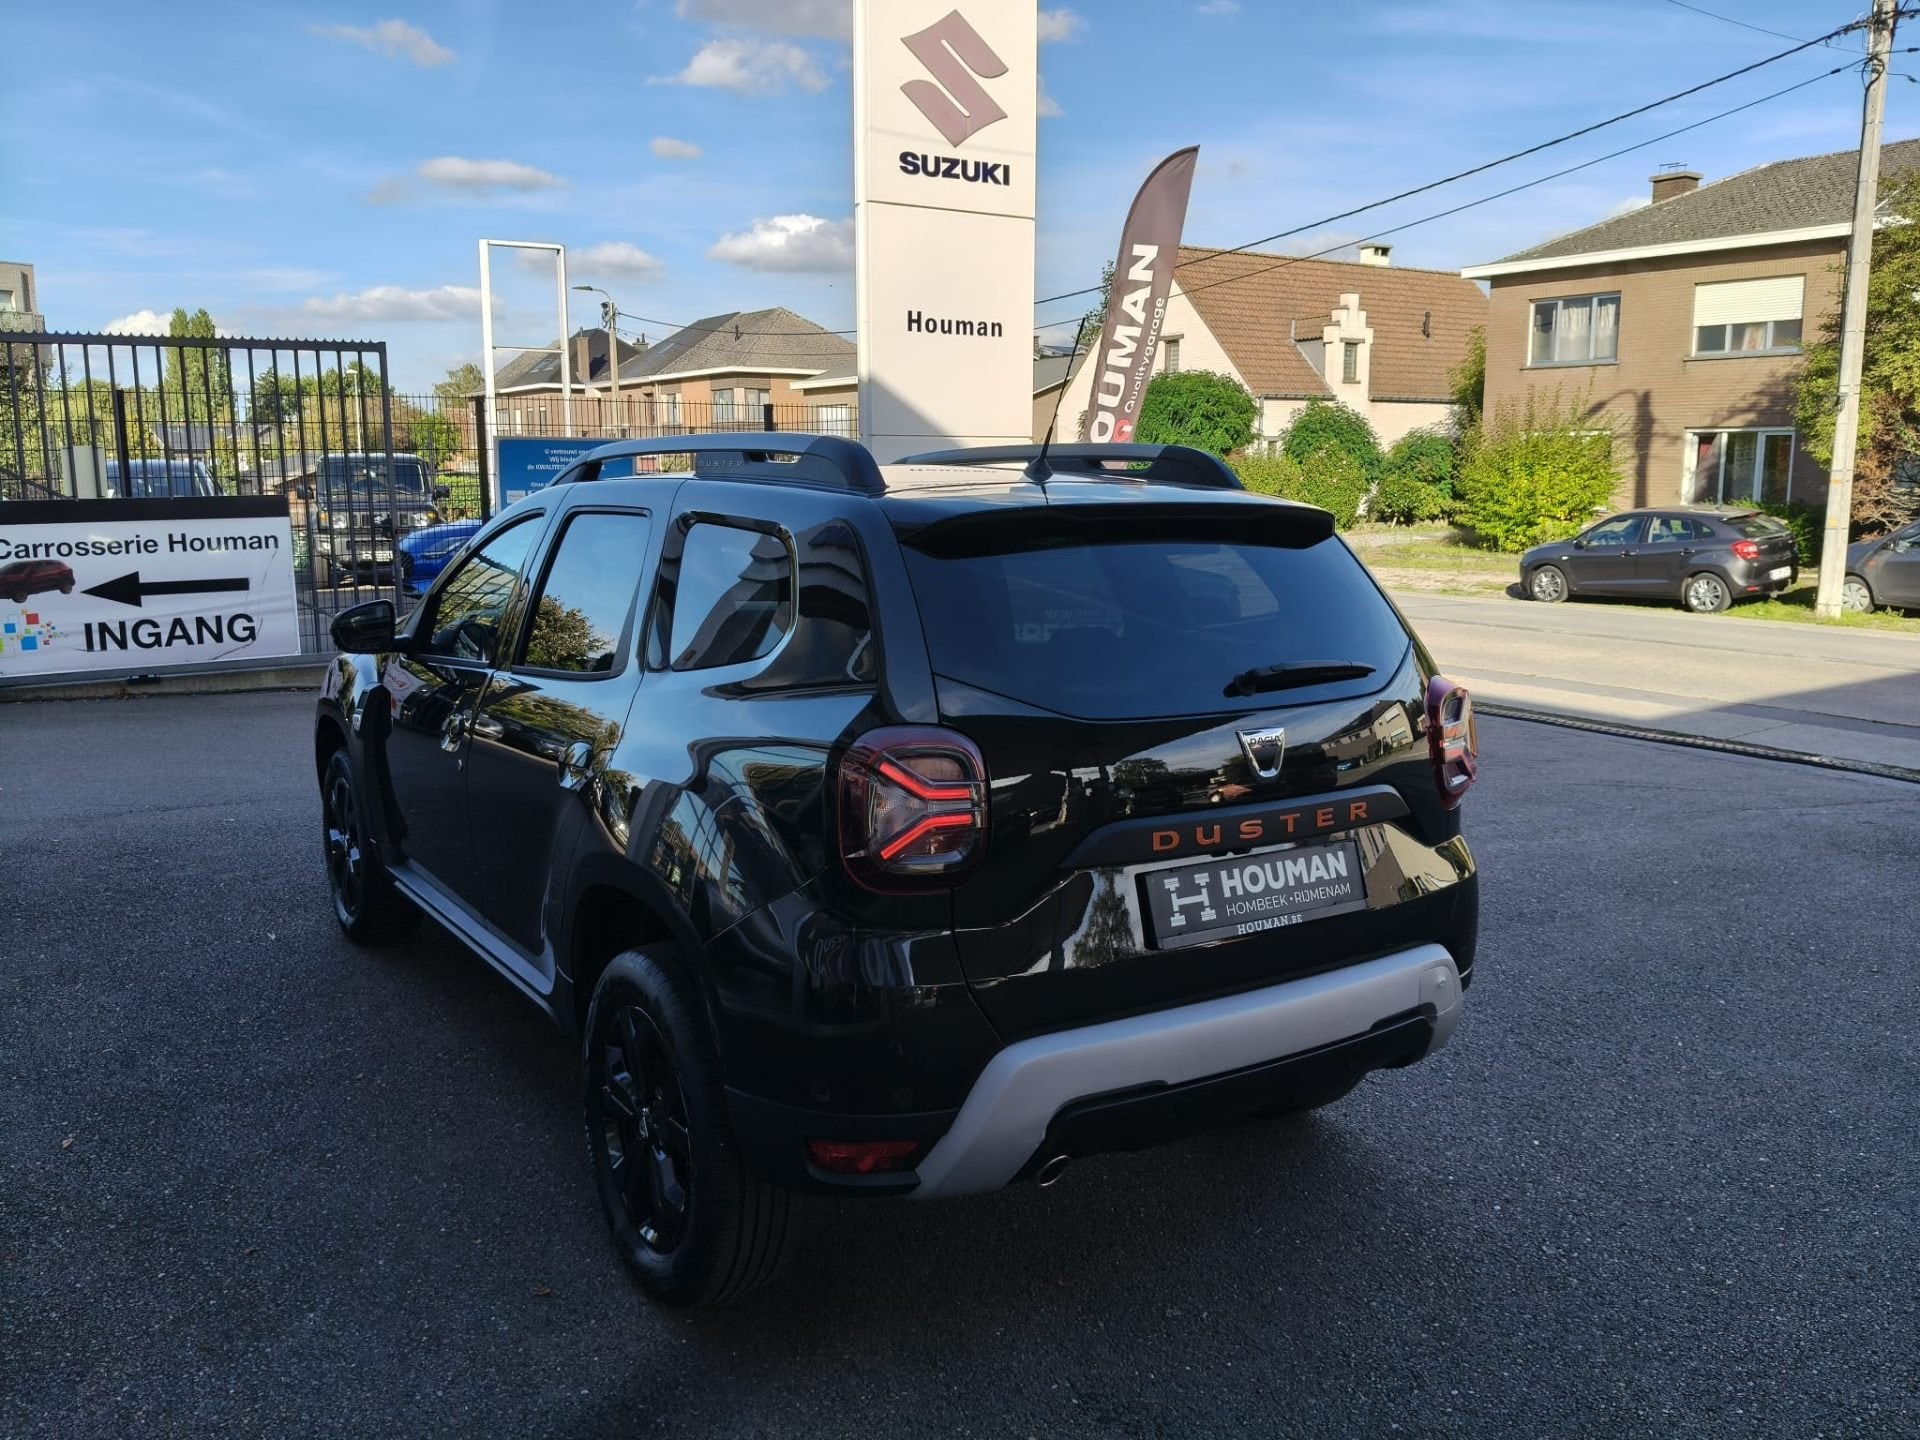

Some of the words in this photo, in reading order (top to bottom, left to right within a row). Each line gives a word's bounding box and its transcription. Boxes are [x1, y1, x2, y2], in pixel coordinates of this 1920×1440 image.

[899, 151, 1010, 186] SUZUKI
[907, 310, 1003, 337] Houman
[1090, 244, 1159, 443] OUMAN
[1125, 297, 1165, 413] Qualitygarage
[0, 534, 159, 560] Carrosserie
[168, 532, 279, 553] Houman
[84, 613, 257, 652] INGANG
[1250, 735, 1282, 745] DACIA
[1152, 801, 1368, 851] DUSTER
[1220, 851, 1348, 898] HOUMAN
[1226, 894, 1288, 917] HOMBEEK
[1294, 882, 1351, 904] RIJMENAM
[1237, 914, 1303, 935] HOUMAN.BE
